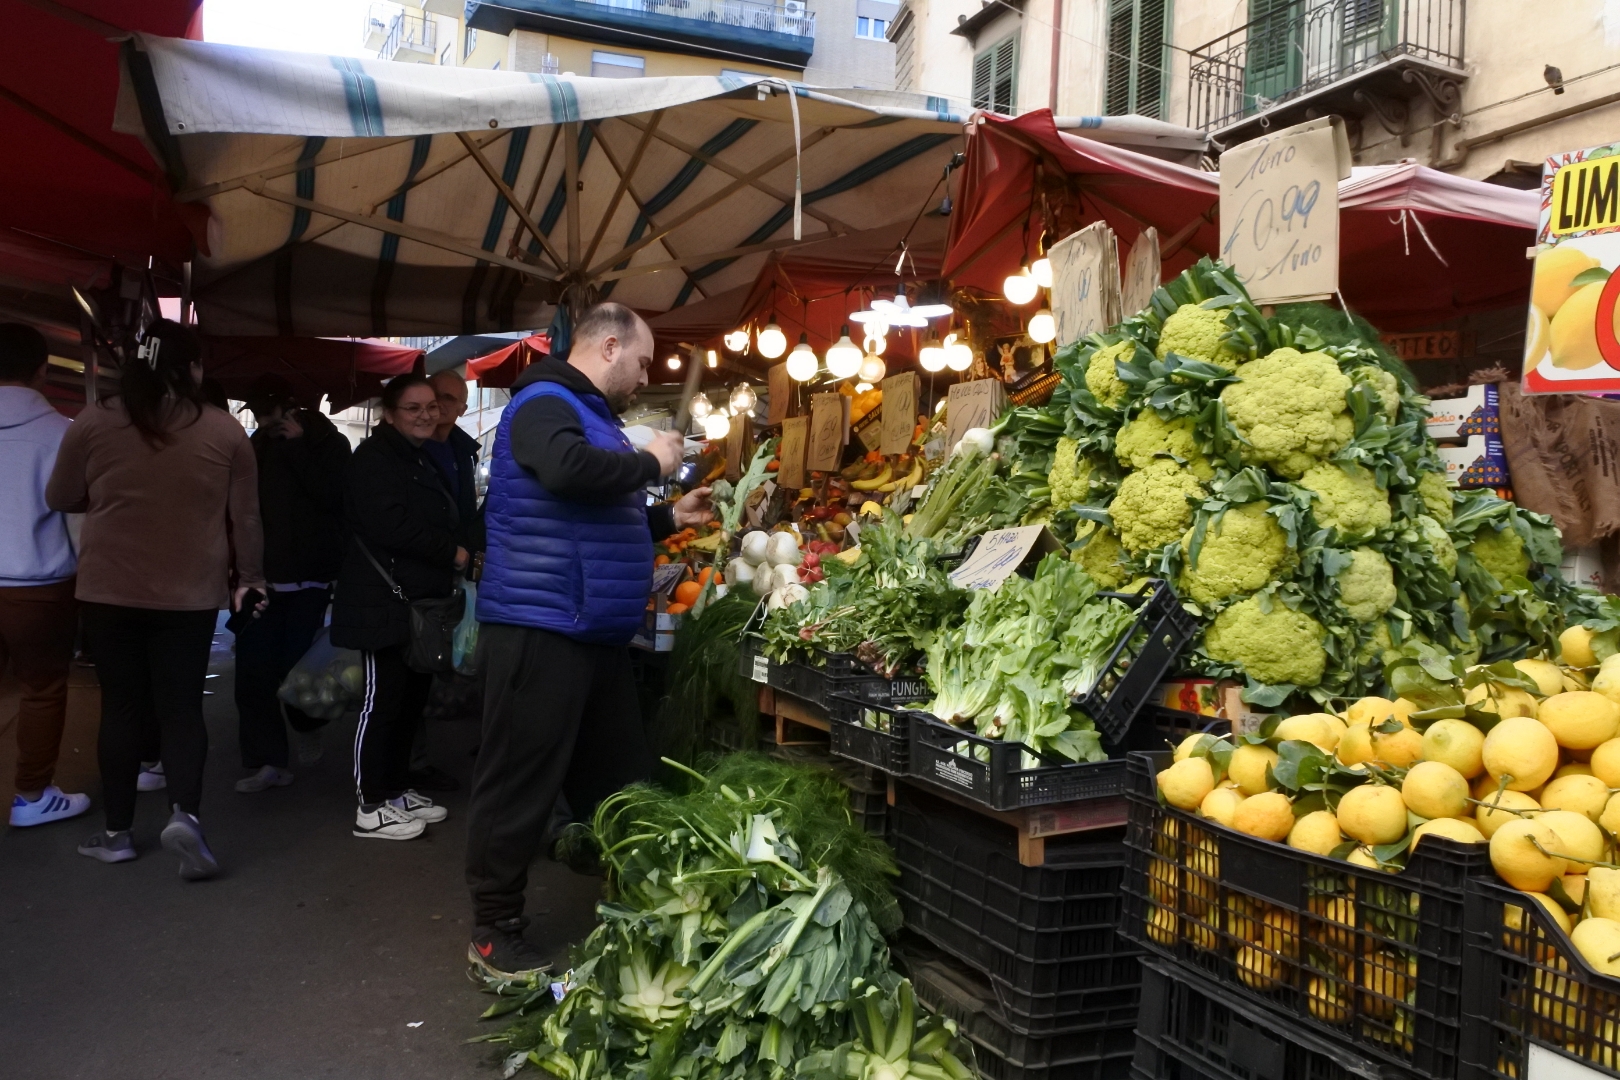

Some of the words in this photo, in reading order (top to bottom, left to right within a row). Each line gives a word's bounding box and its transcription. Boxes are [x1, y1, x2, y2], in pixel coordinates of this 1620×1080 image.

[1558, 161, 1619, 230] LIM
[985, 533, 999, 551] 5
[891, 681, 930, 697] FUNGH
